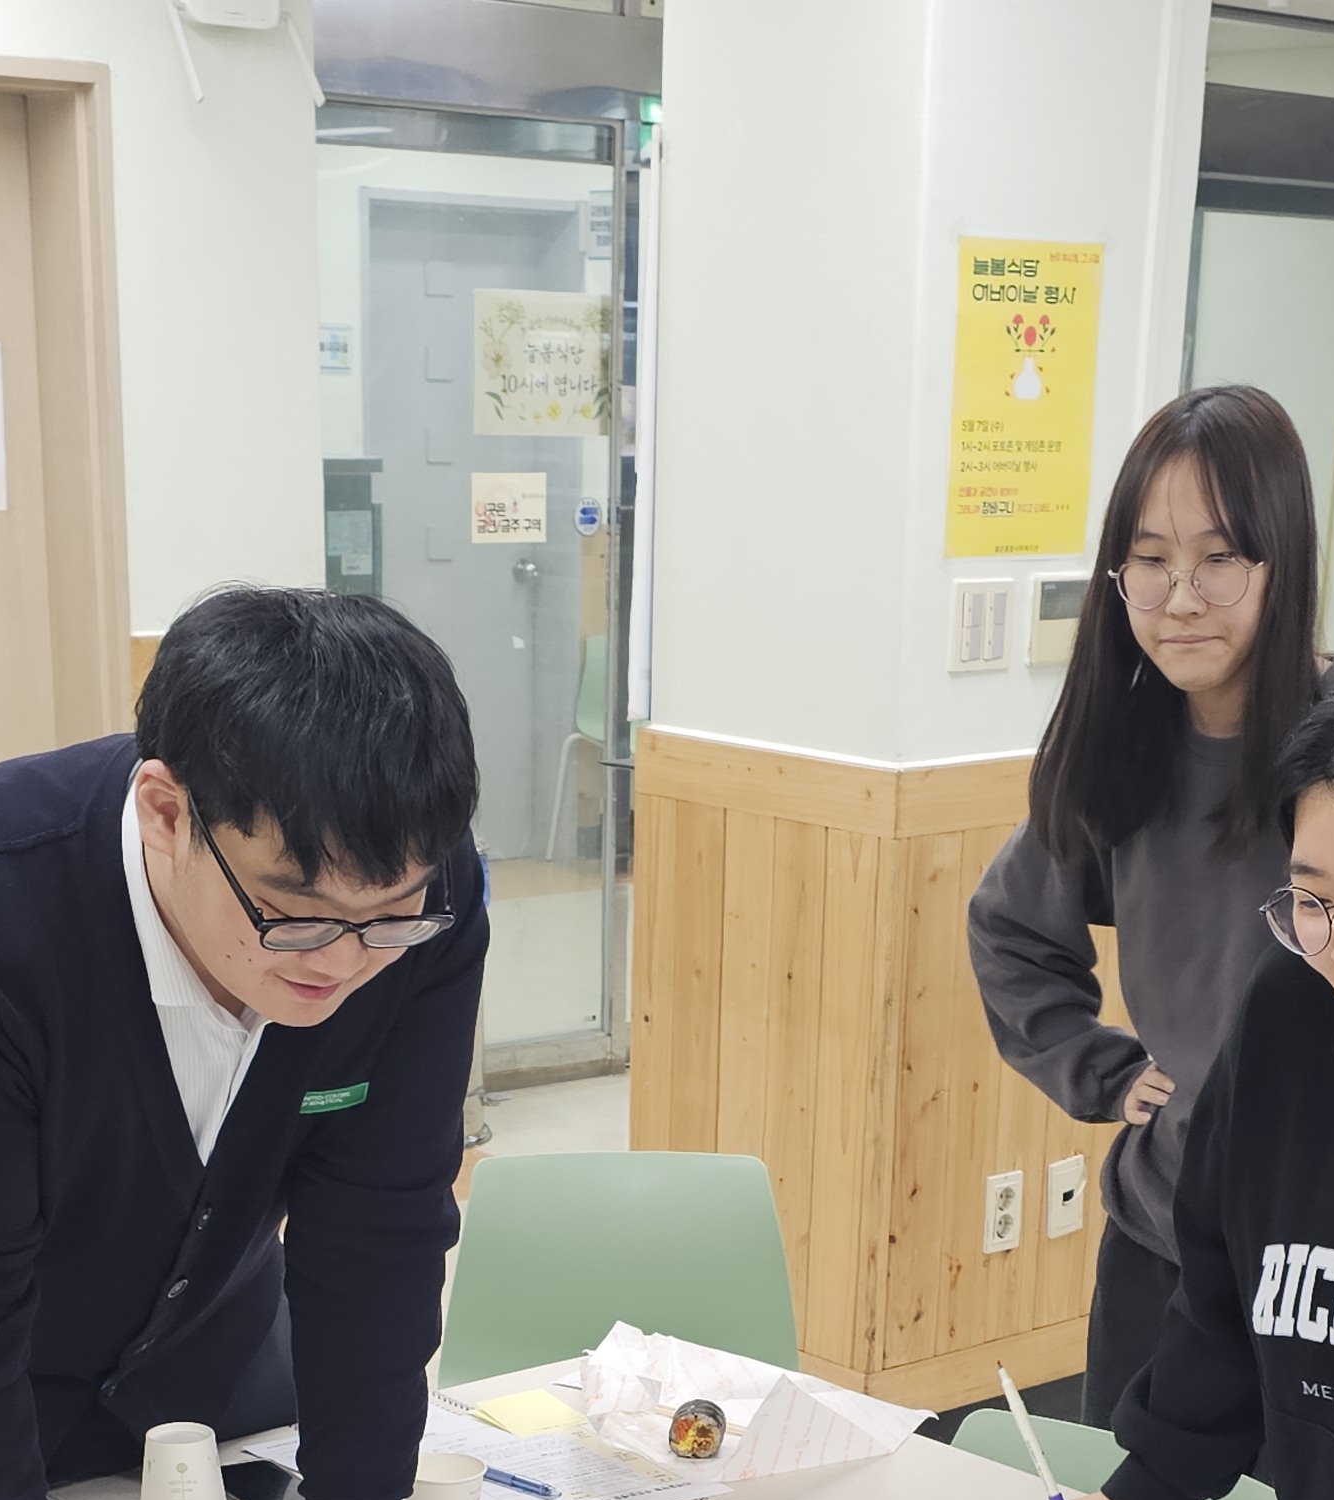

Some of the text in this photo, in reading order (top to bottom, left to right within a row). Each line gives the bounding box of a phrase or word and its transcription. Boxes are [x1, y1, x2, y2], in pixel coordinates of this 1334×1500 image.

[973, 256, 1040, 277] 늘봄식당
[972, 283, 1076, 304] 어버이날 행사
[523, 341, 585, 364] 늘봄식당
[501, 374, 549, 395] 10시에
[961, 420, 1004, 433] 5월 7일 (수)
[961, 440, 991, 452] 1시~2시
[960, 461, 991, 472] 2시~3시
[523, 518, 541, 532] 구역
